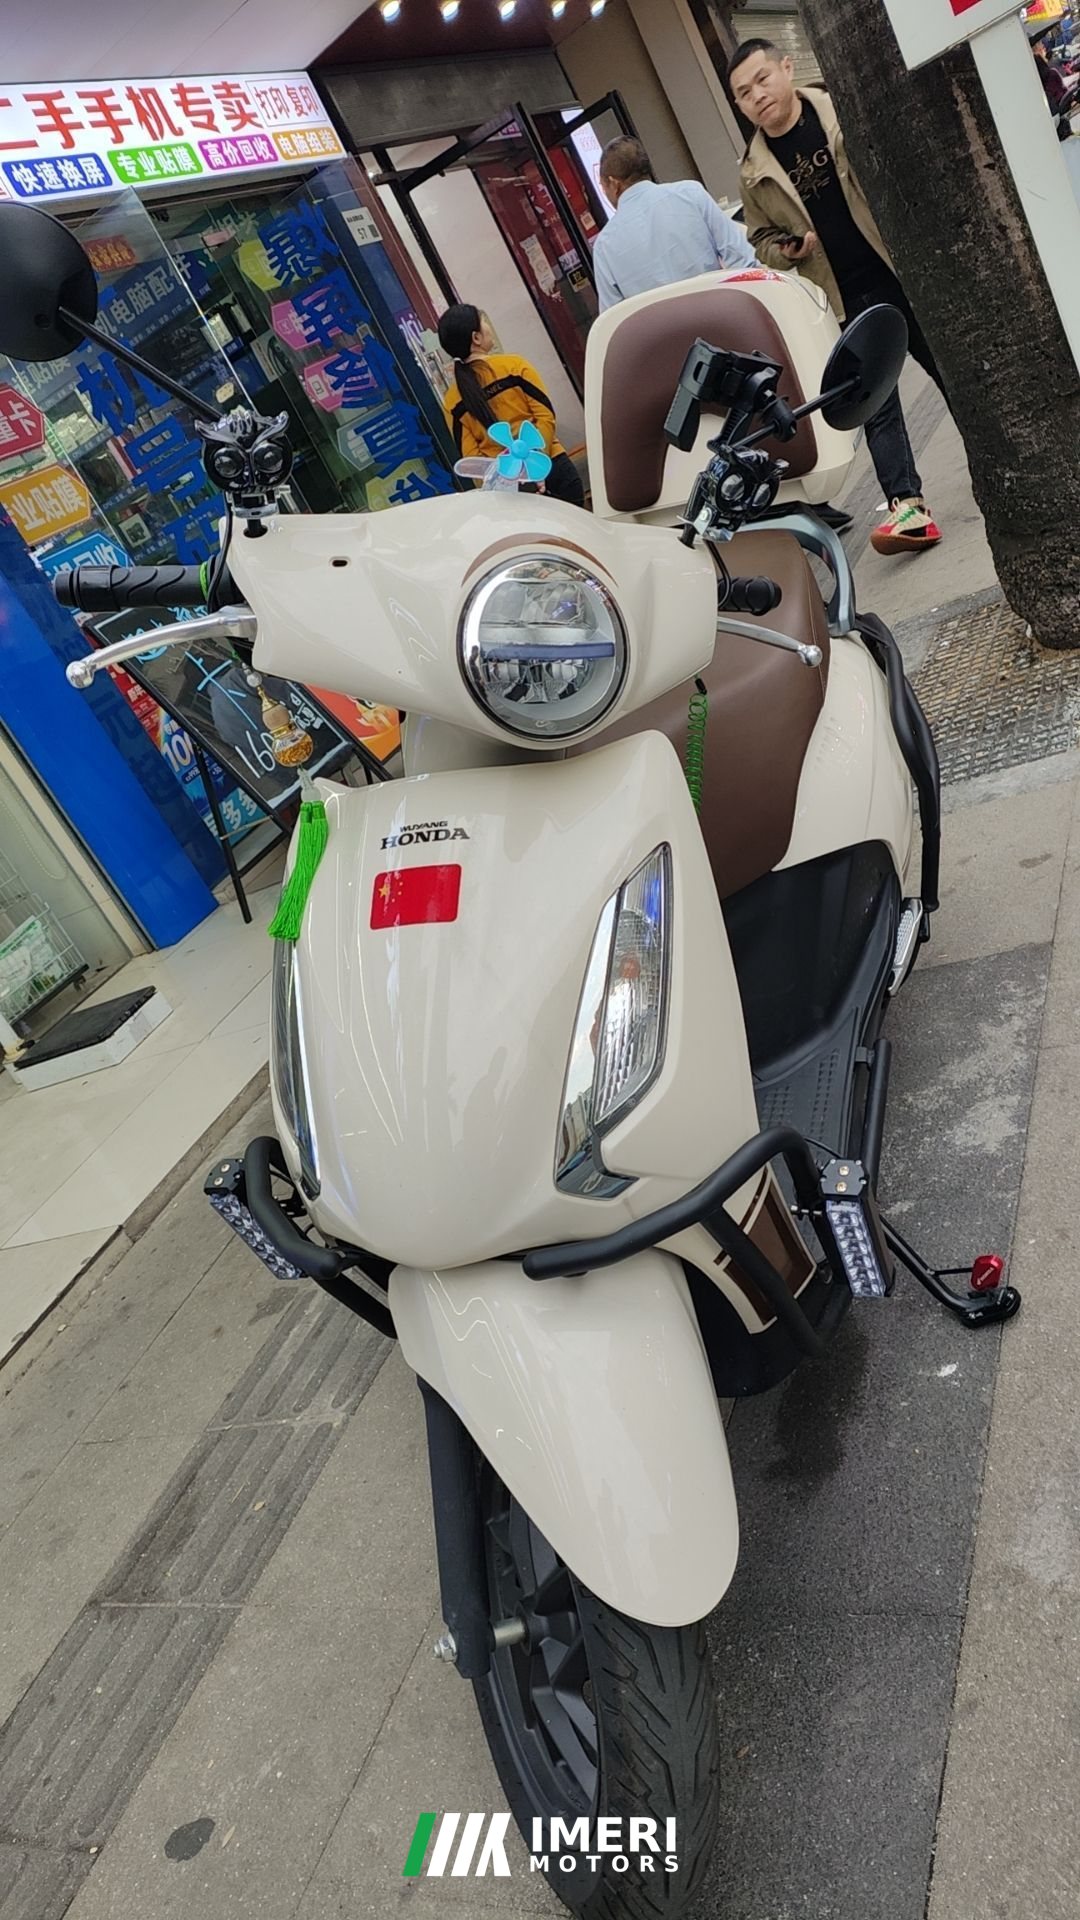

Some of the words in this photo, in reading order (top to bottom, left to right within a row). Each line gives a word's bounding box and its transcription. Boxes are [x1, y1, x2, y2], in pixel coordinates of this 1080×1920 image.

[254, 84, 319, 120] 打印复印
[202, 136, 275, 169] 高价回收
[278, 130, 338, 156] 电脑组装
[11, 156, 105, 193] 快速换屏
[117, 146, 197, 179] 专业贴膜
[2, 474, 87, 532] 业贴膜
[380, 828, 470, 850] HONDA
[400, 820, 448, 833] WUYANG
